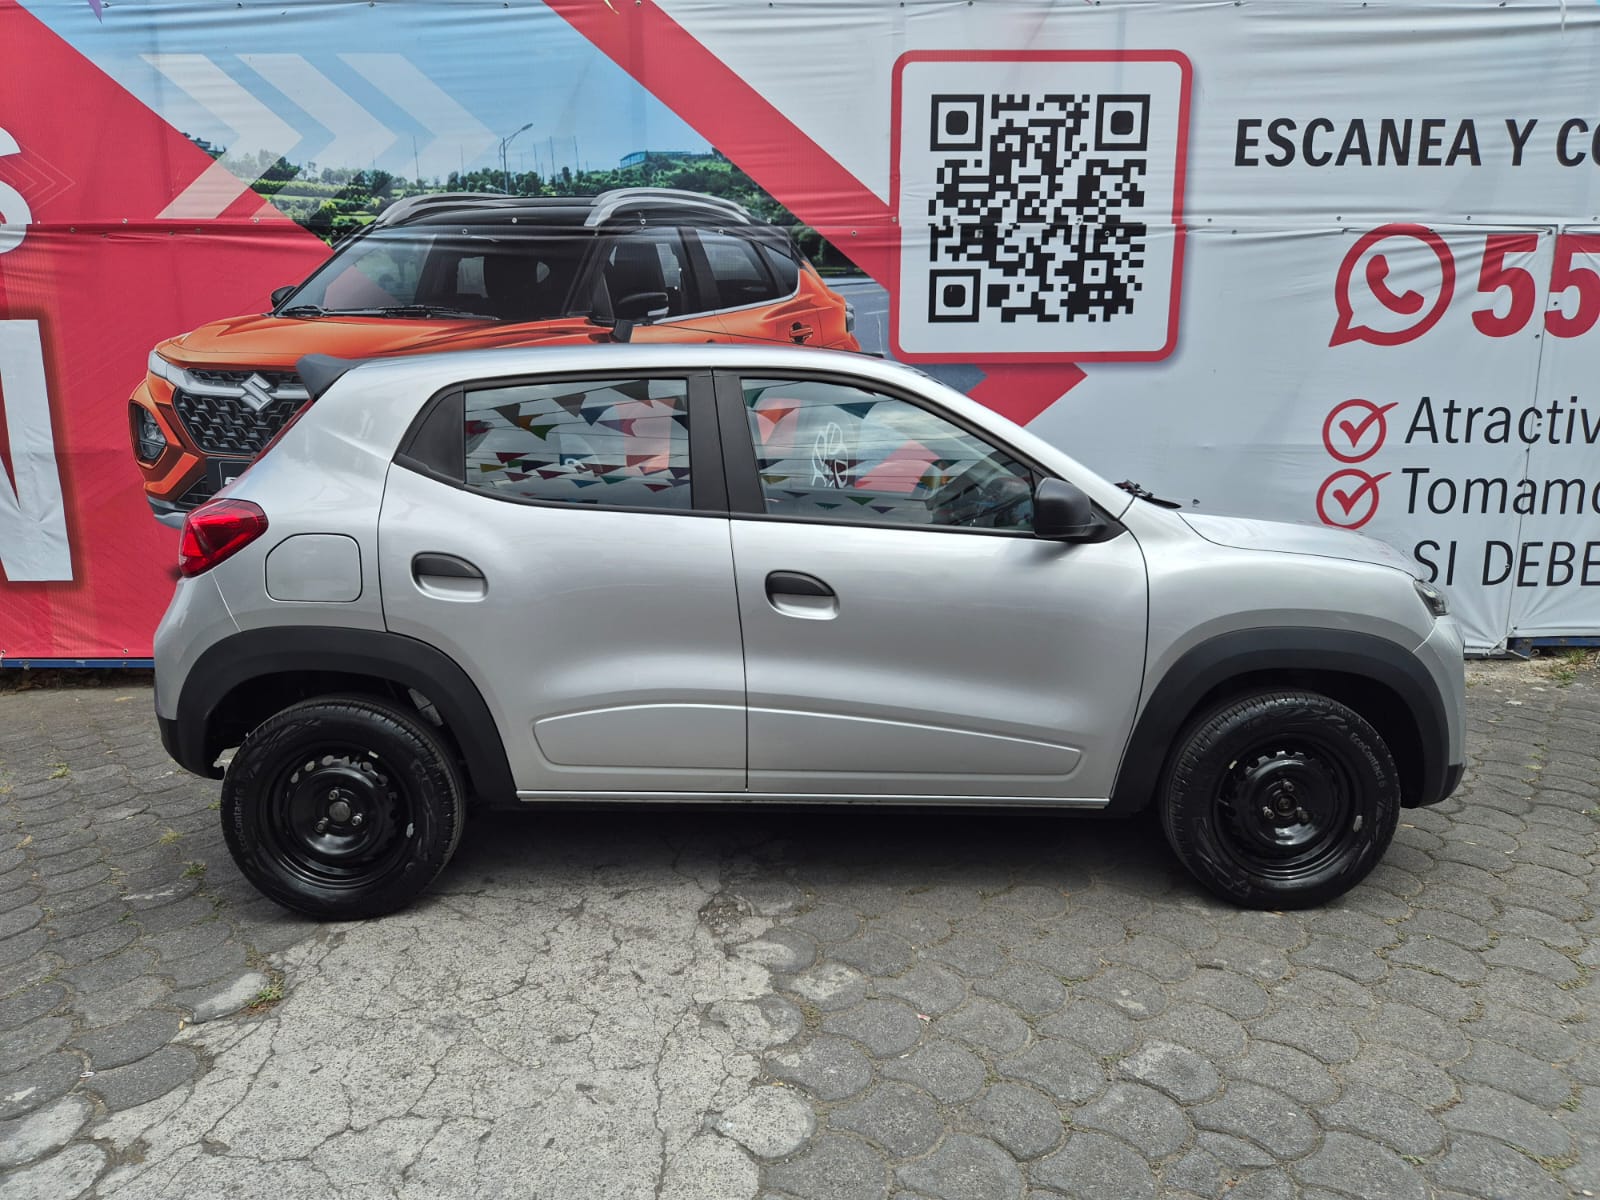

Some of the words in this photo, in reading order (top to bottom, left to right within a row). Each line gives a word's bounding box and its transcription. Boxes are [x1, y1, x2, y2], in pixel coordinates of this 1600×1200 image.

[1234, 117, 1482, 167] ESCANEA
[1505, 118, 1538, 166] Y
[1556, 117, 1600, 167] C
[1471, 232, 1600, 338] 55
[1405, 395, 1600, 445] Atractiv
[1413, 539, 1457, 586] SI
[1482, 540, 1600, 587] DEBE
